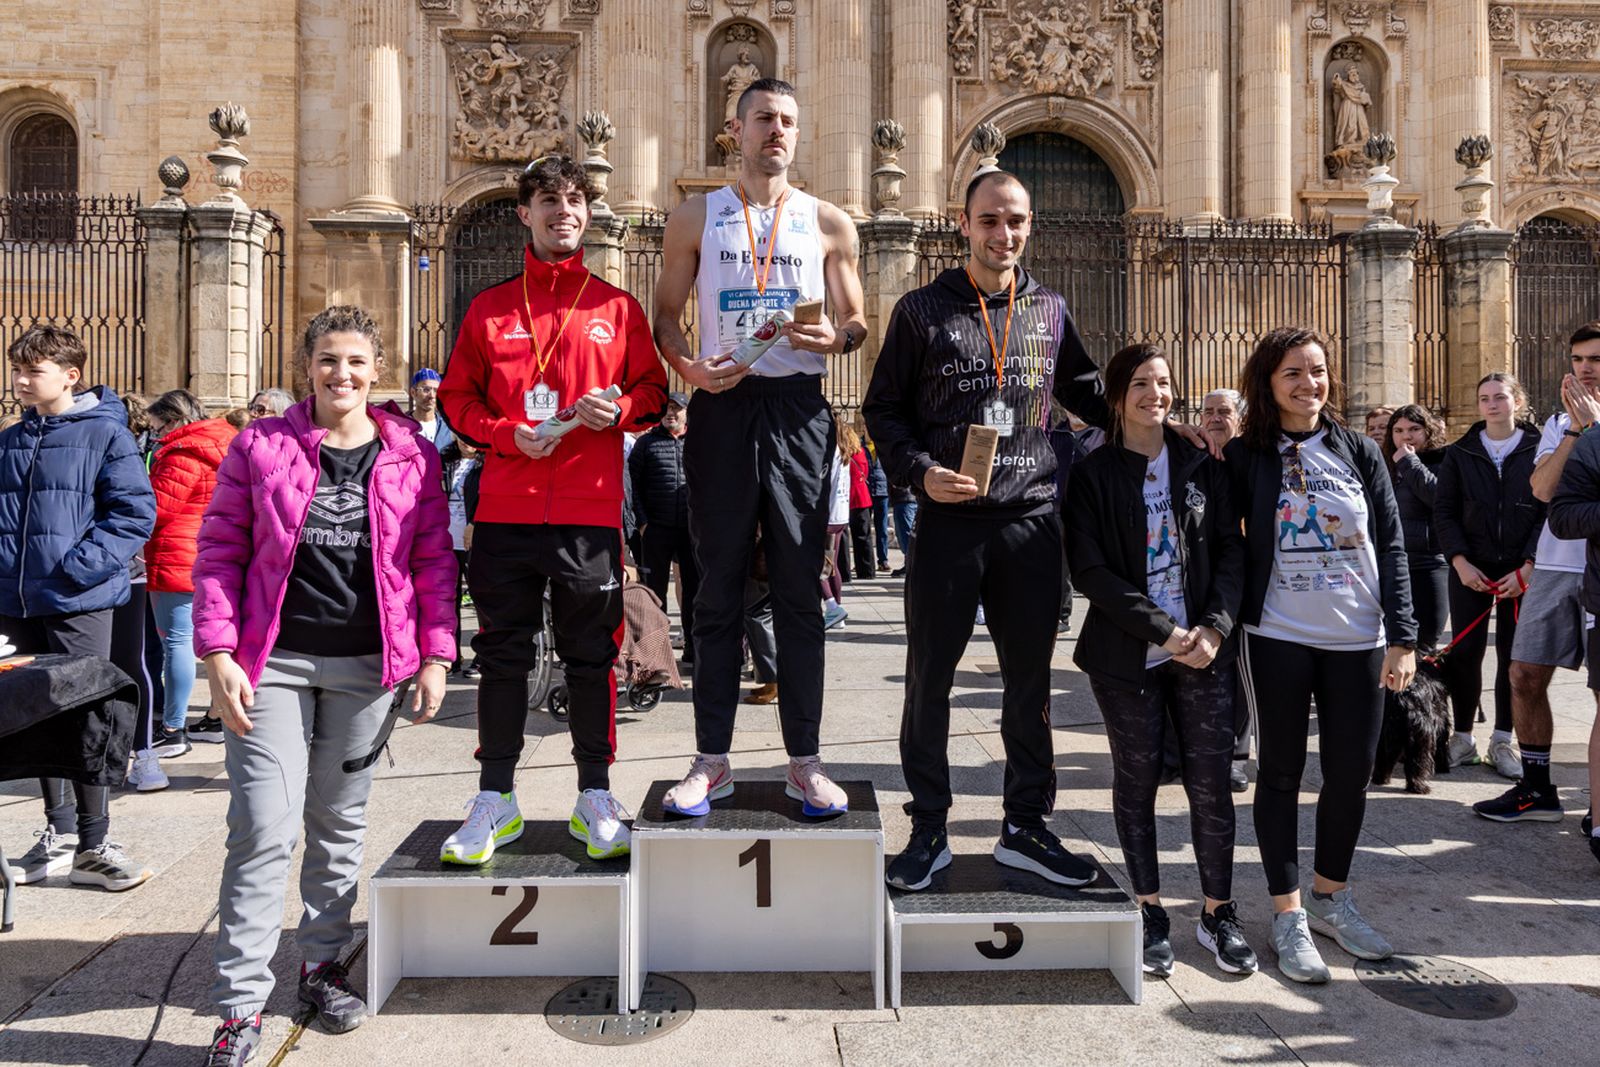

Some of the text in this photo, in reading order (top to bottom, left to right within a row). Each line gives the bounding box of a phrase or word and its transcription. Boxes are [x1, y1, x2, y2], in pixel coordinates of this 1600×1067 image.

[720, 250, 737, 261] Da
[728, 299, 750, 309] BUENA
[941, 352, 1054, 377] club running
[738, 839, 771, 908] 1
[489, 886, 539, 946] 2
